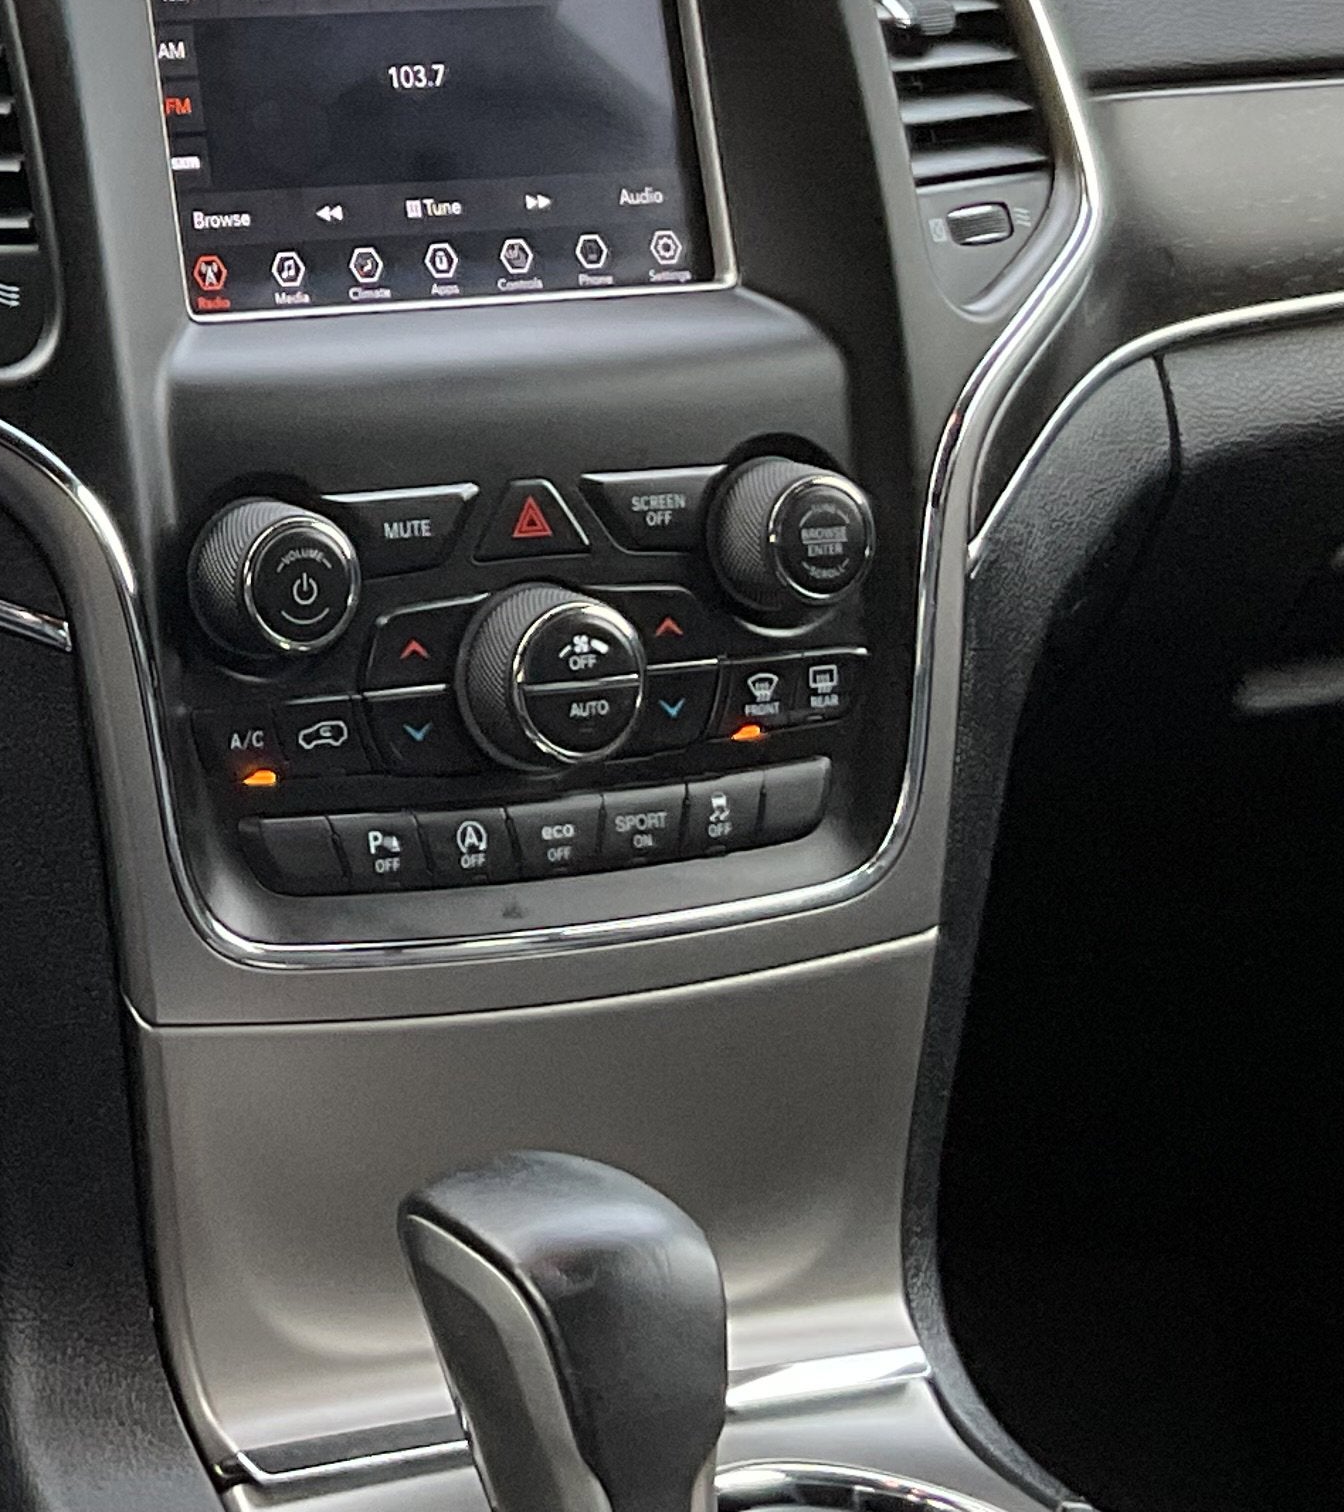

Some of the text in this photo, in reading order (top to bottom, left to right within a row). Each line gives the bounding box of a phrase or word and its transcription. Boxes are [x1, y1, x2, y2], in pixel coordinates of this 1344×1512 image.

[158, 41, 185, 60] AM
[388, 64, 446, 89] 103.7
[165, 97, 192, 115] FM
[619, 187, 664, 206] Audio
[422, 198, 462, 217] Tune
[192, 210, 251, 230] Browse
[632, 494, 686, 511] SCREEN
[646, 510, 673, 526] OFF
[384, 519, 432, 539] MUTE
[281, 548, 324, 565] VOLUME
[568, 654, 597, 671] OFF
[569, 700, 610, 717] AUTO
[745, 701, 780, 716] FRONT
[811, 694, 840, 708] REAR
[231, 729, 264, 749] A/C
[615, 811, 668, 832] SPORT
[708, 821, 733, 838] OFF
[541, 824, 575, 841] eco
[633, 834, 653, 848] ON
[460, 854, 487, 869] OFF
[547, 846, 573, 862] OFF
[374, 858, 401, 873] OFF
